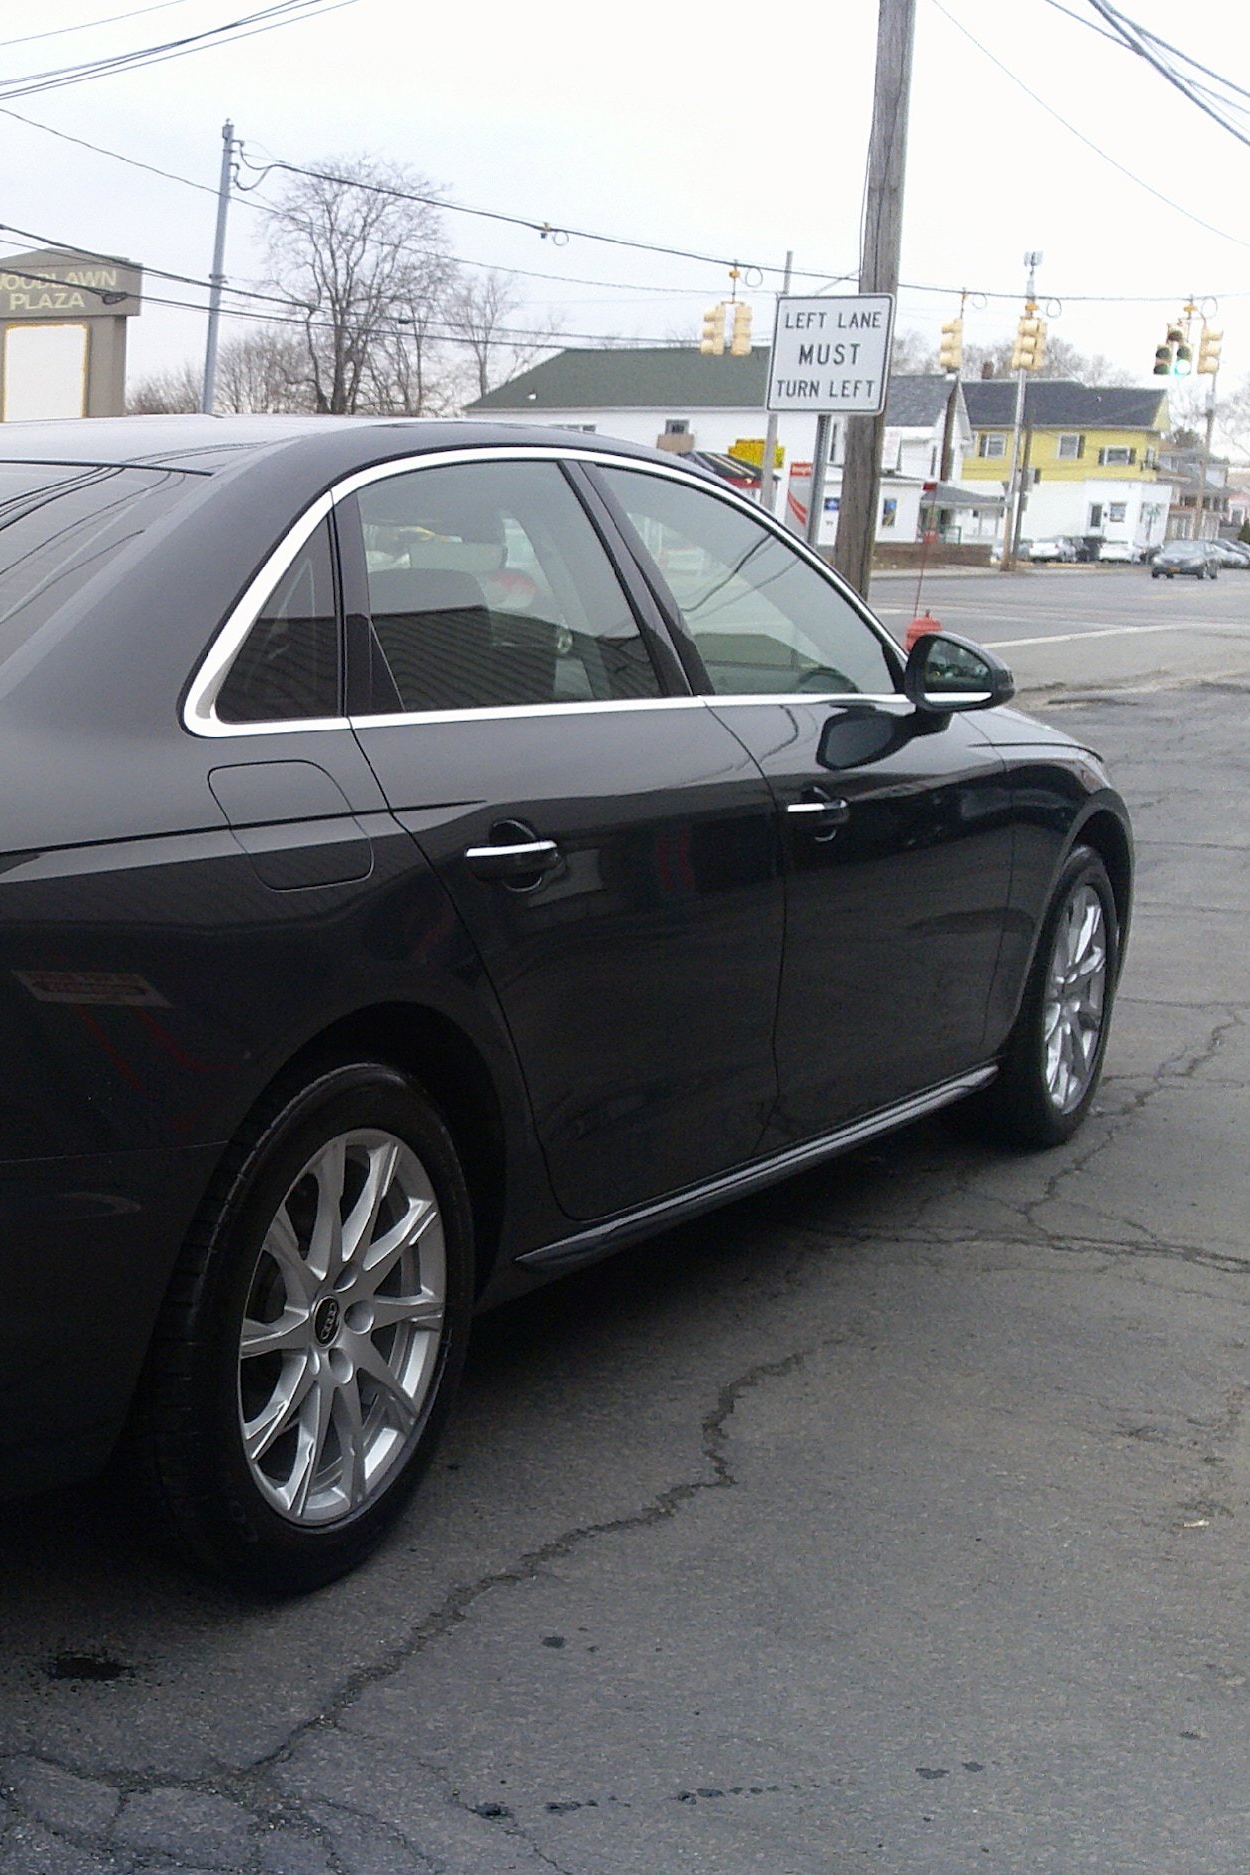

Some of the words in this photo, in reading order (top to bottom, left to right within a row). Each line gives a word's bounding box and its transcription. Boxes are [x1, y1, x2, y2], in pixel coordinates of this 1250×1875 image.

[10, 292, 85, 310] PLAZA
[785, 312, 827, 329] LEFT
[838, 312, 882, 329] LANE
[798, 343, 861, 365] MUST
[777, 380, 820, 398] TURN
[829, 380, 875, 398] LEFT
